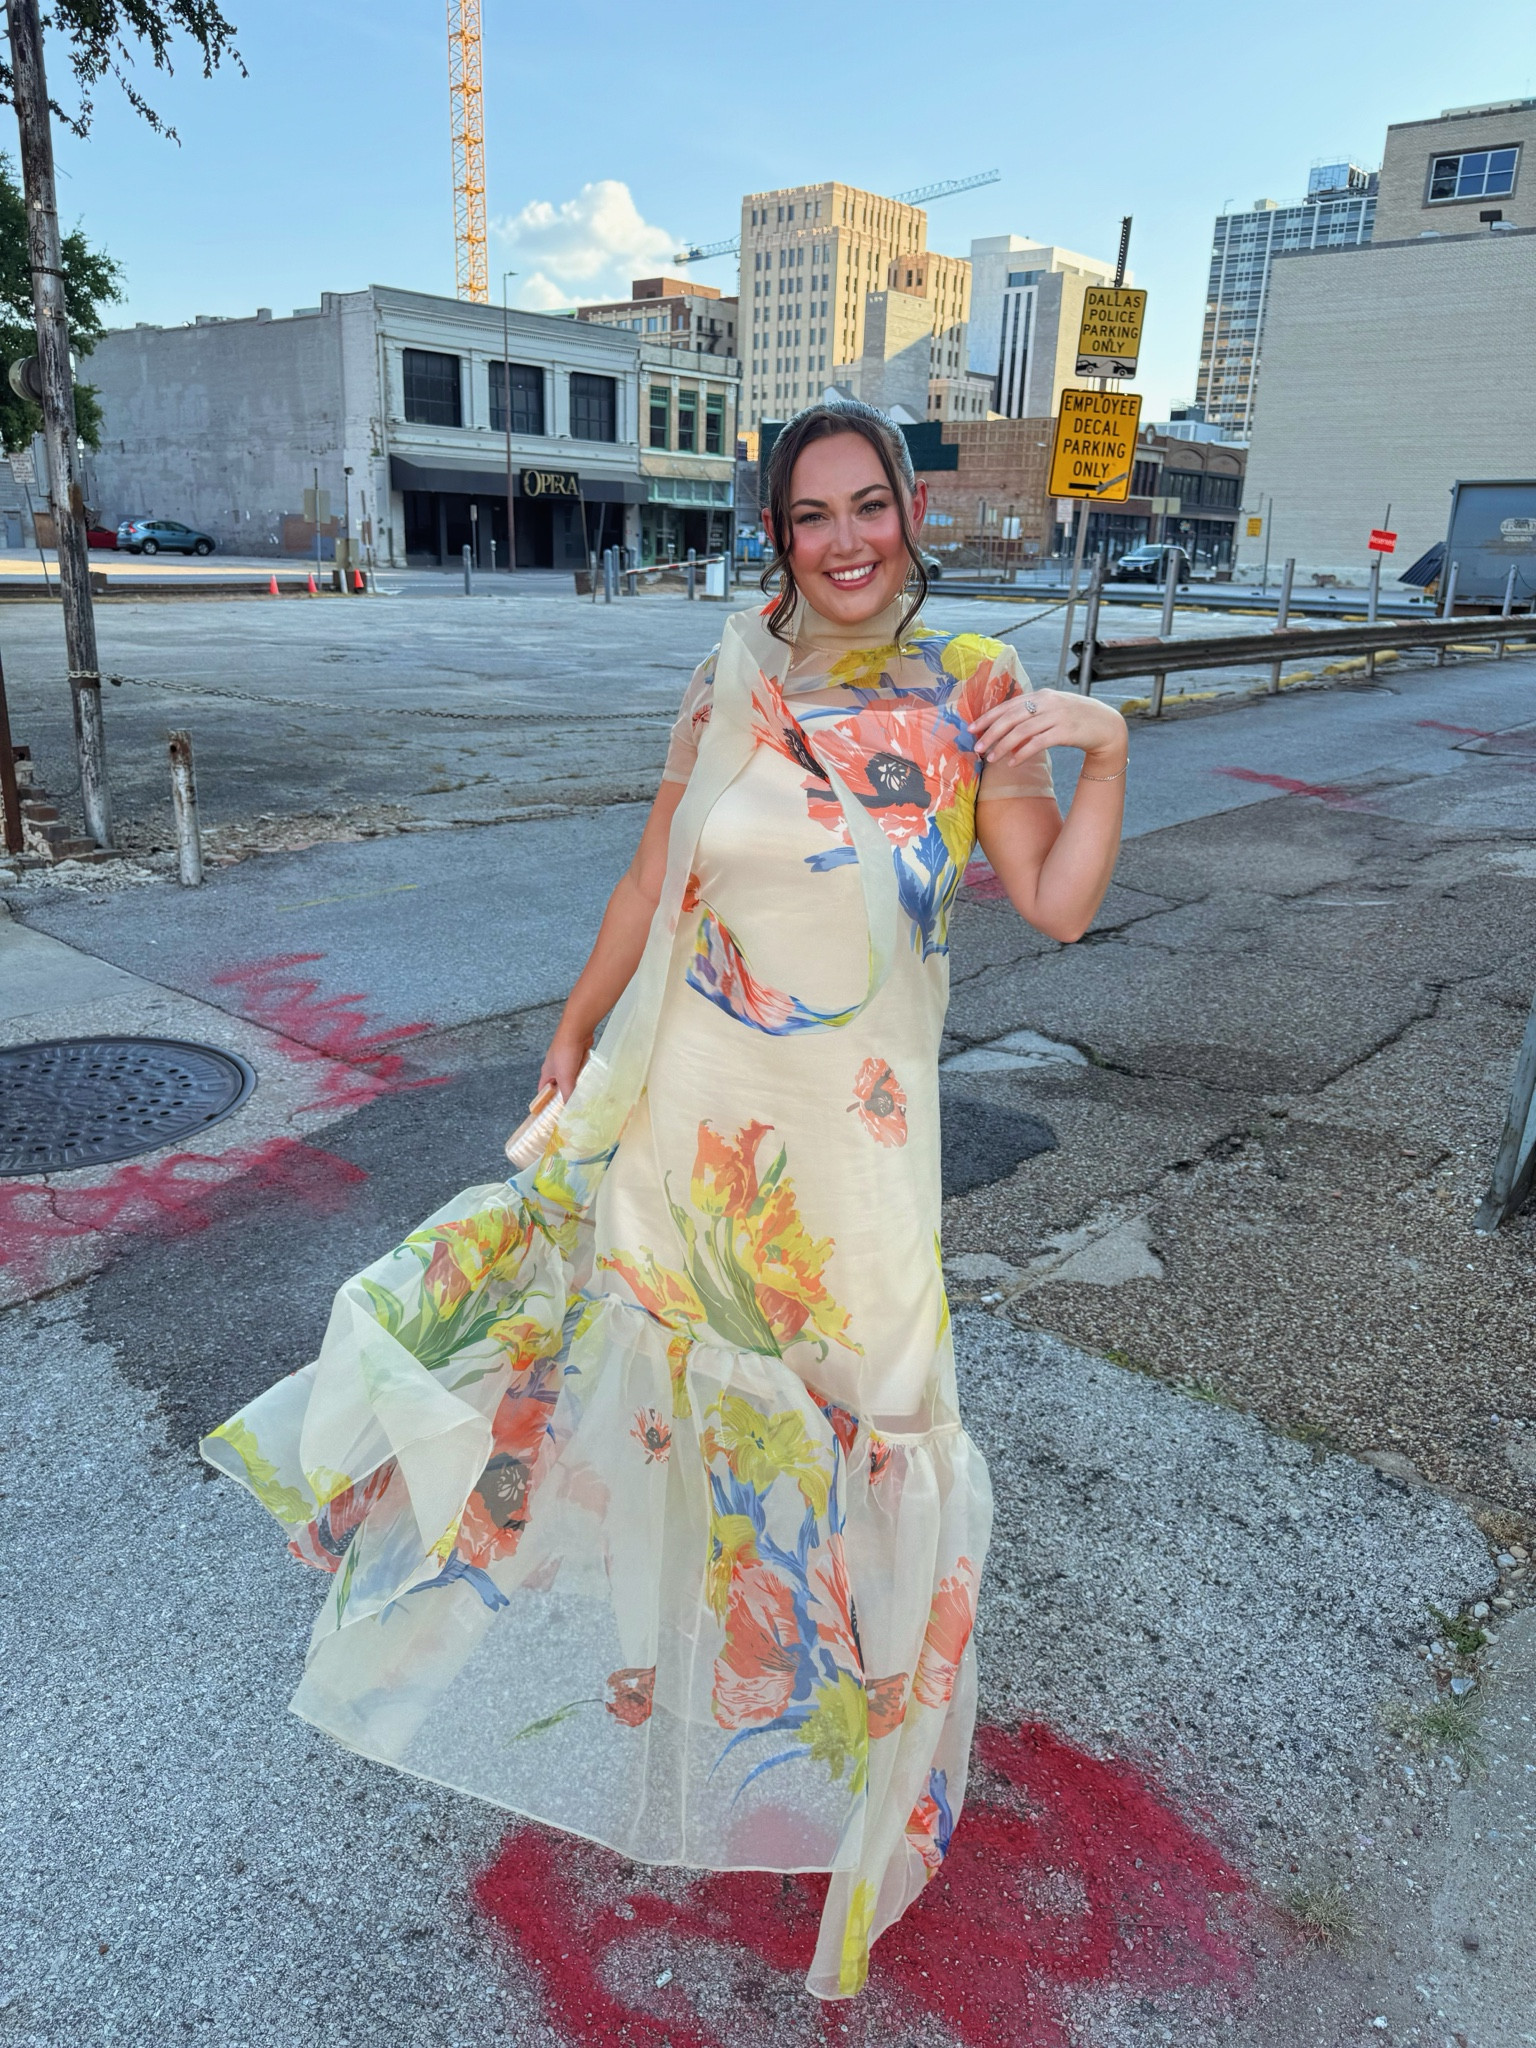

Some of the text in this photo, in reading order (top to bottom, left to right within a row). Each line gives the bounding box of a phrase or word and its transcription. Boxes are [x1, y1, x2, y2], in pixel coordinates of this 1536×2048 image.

[1088, 293, 1141, 308] DALLAS
[1089, 309, 1136, 324] POLICE
[1082, 324, 1139, 339] PARKING
[1092, 339, 1125, 353] ONLY
[1064, 395, 1138, 417] EMPLOYEE
[1073, 418, 1120, 437] DECAL
[1062, 439, 1126, 459] PARKING
[1073, 461, 1110, 479] ONLY
[524, 470, 579, 497] OPERA
